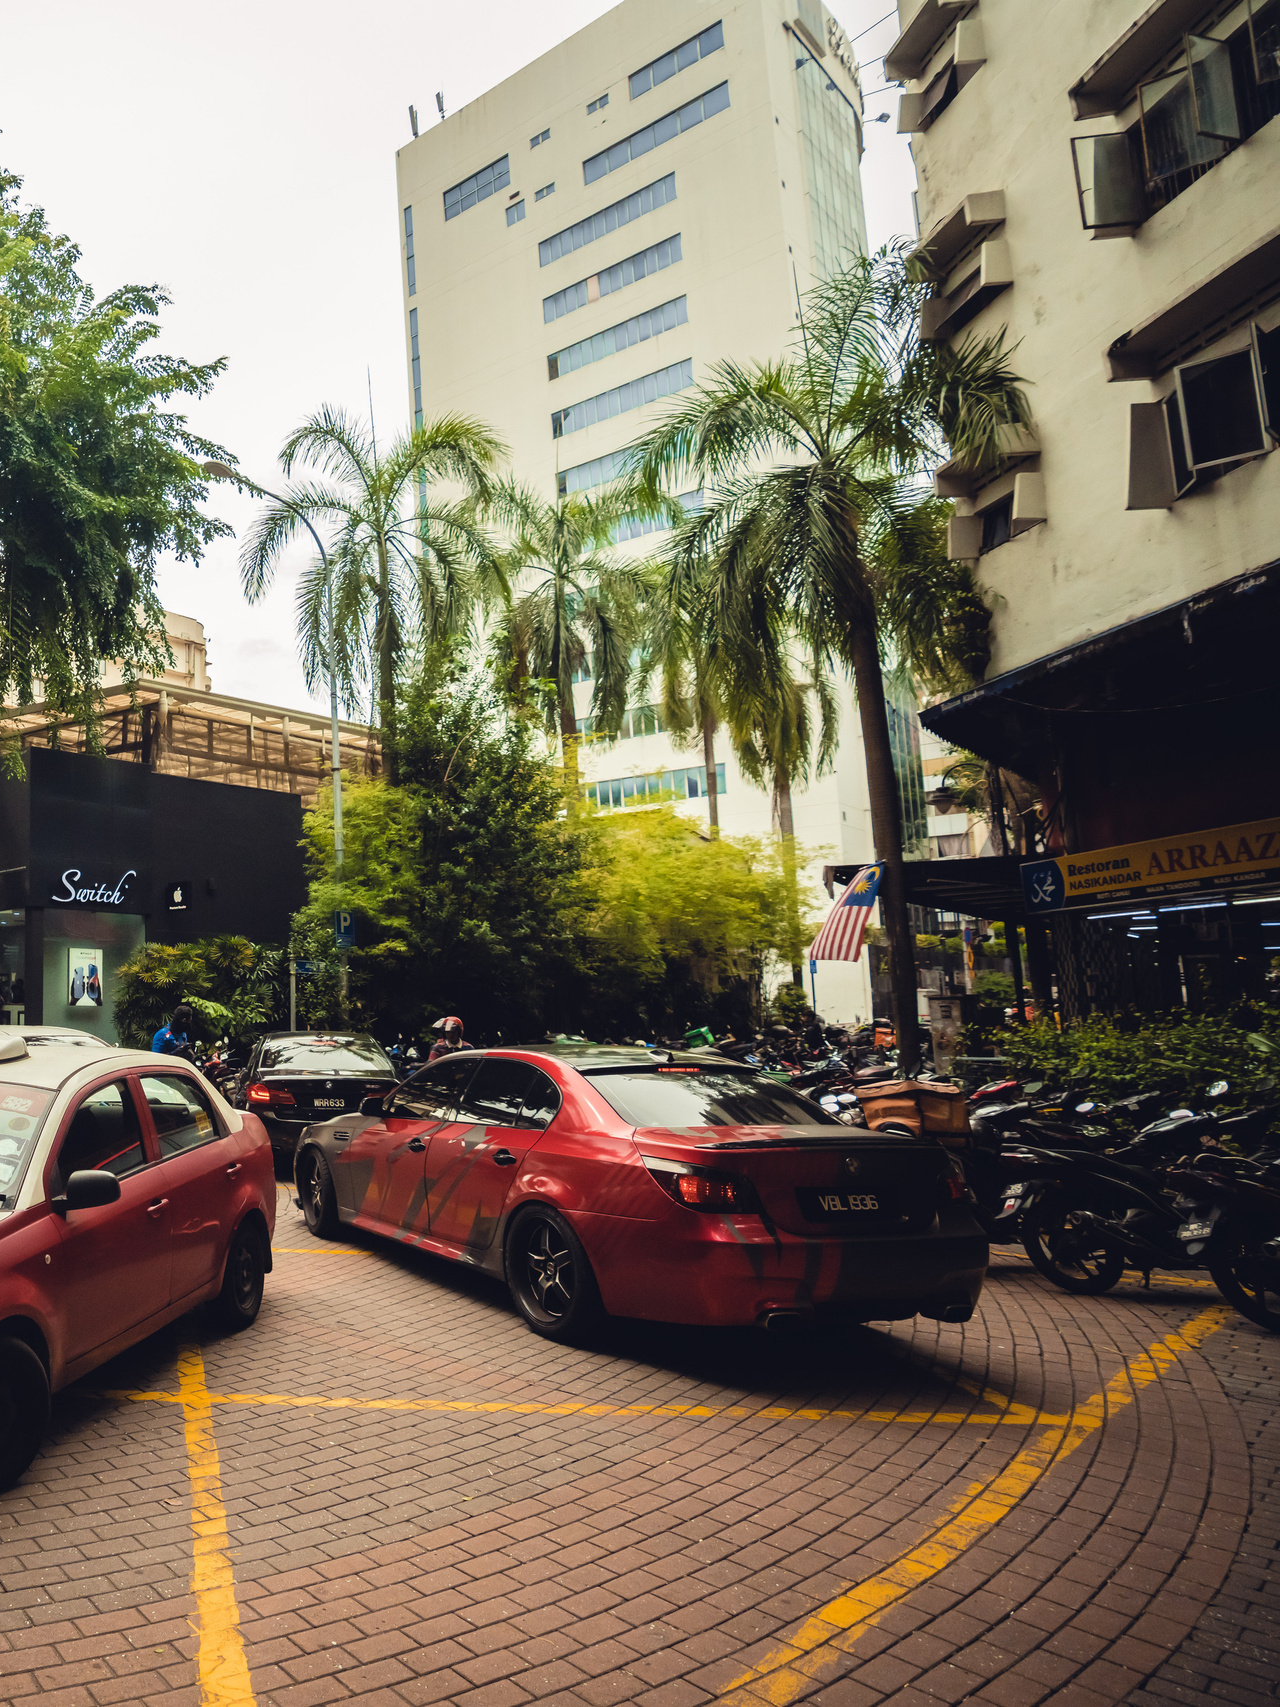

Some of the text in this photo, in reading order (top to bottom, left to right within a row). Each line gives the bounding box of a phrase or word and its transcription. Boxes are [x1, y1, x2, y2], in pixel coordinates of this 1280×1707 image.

[1067, 858, 1130, 877] Restoran
[52, 869, 137, 904] Switch
[340, 912, 351, 934] P
